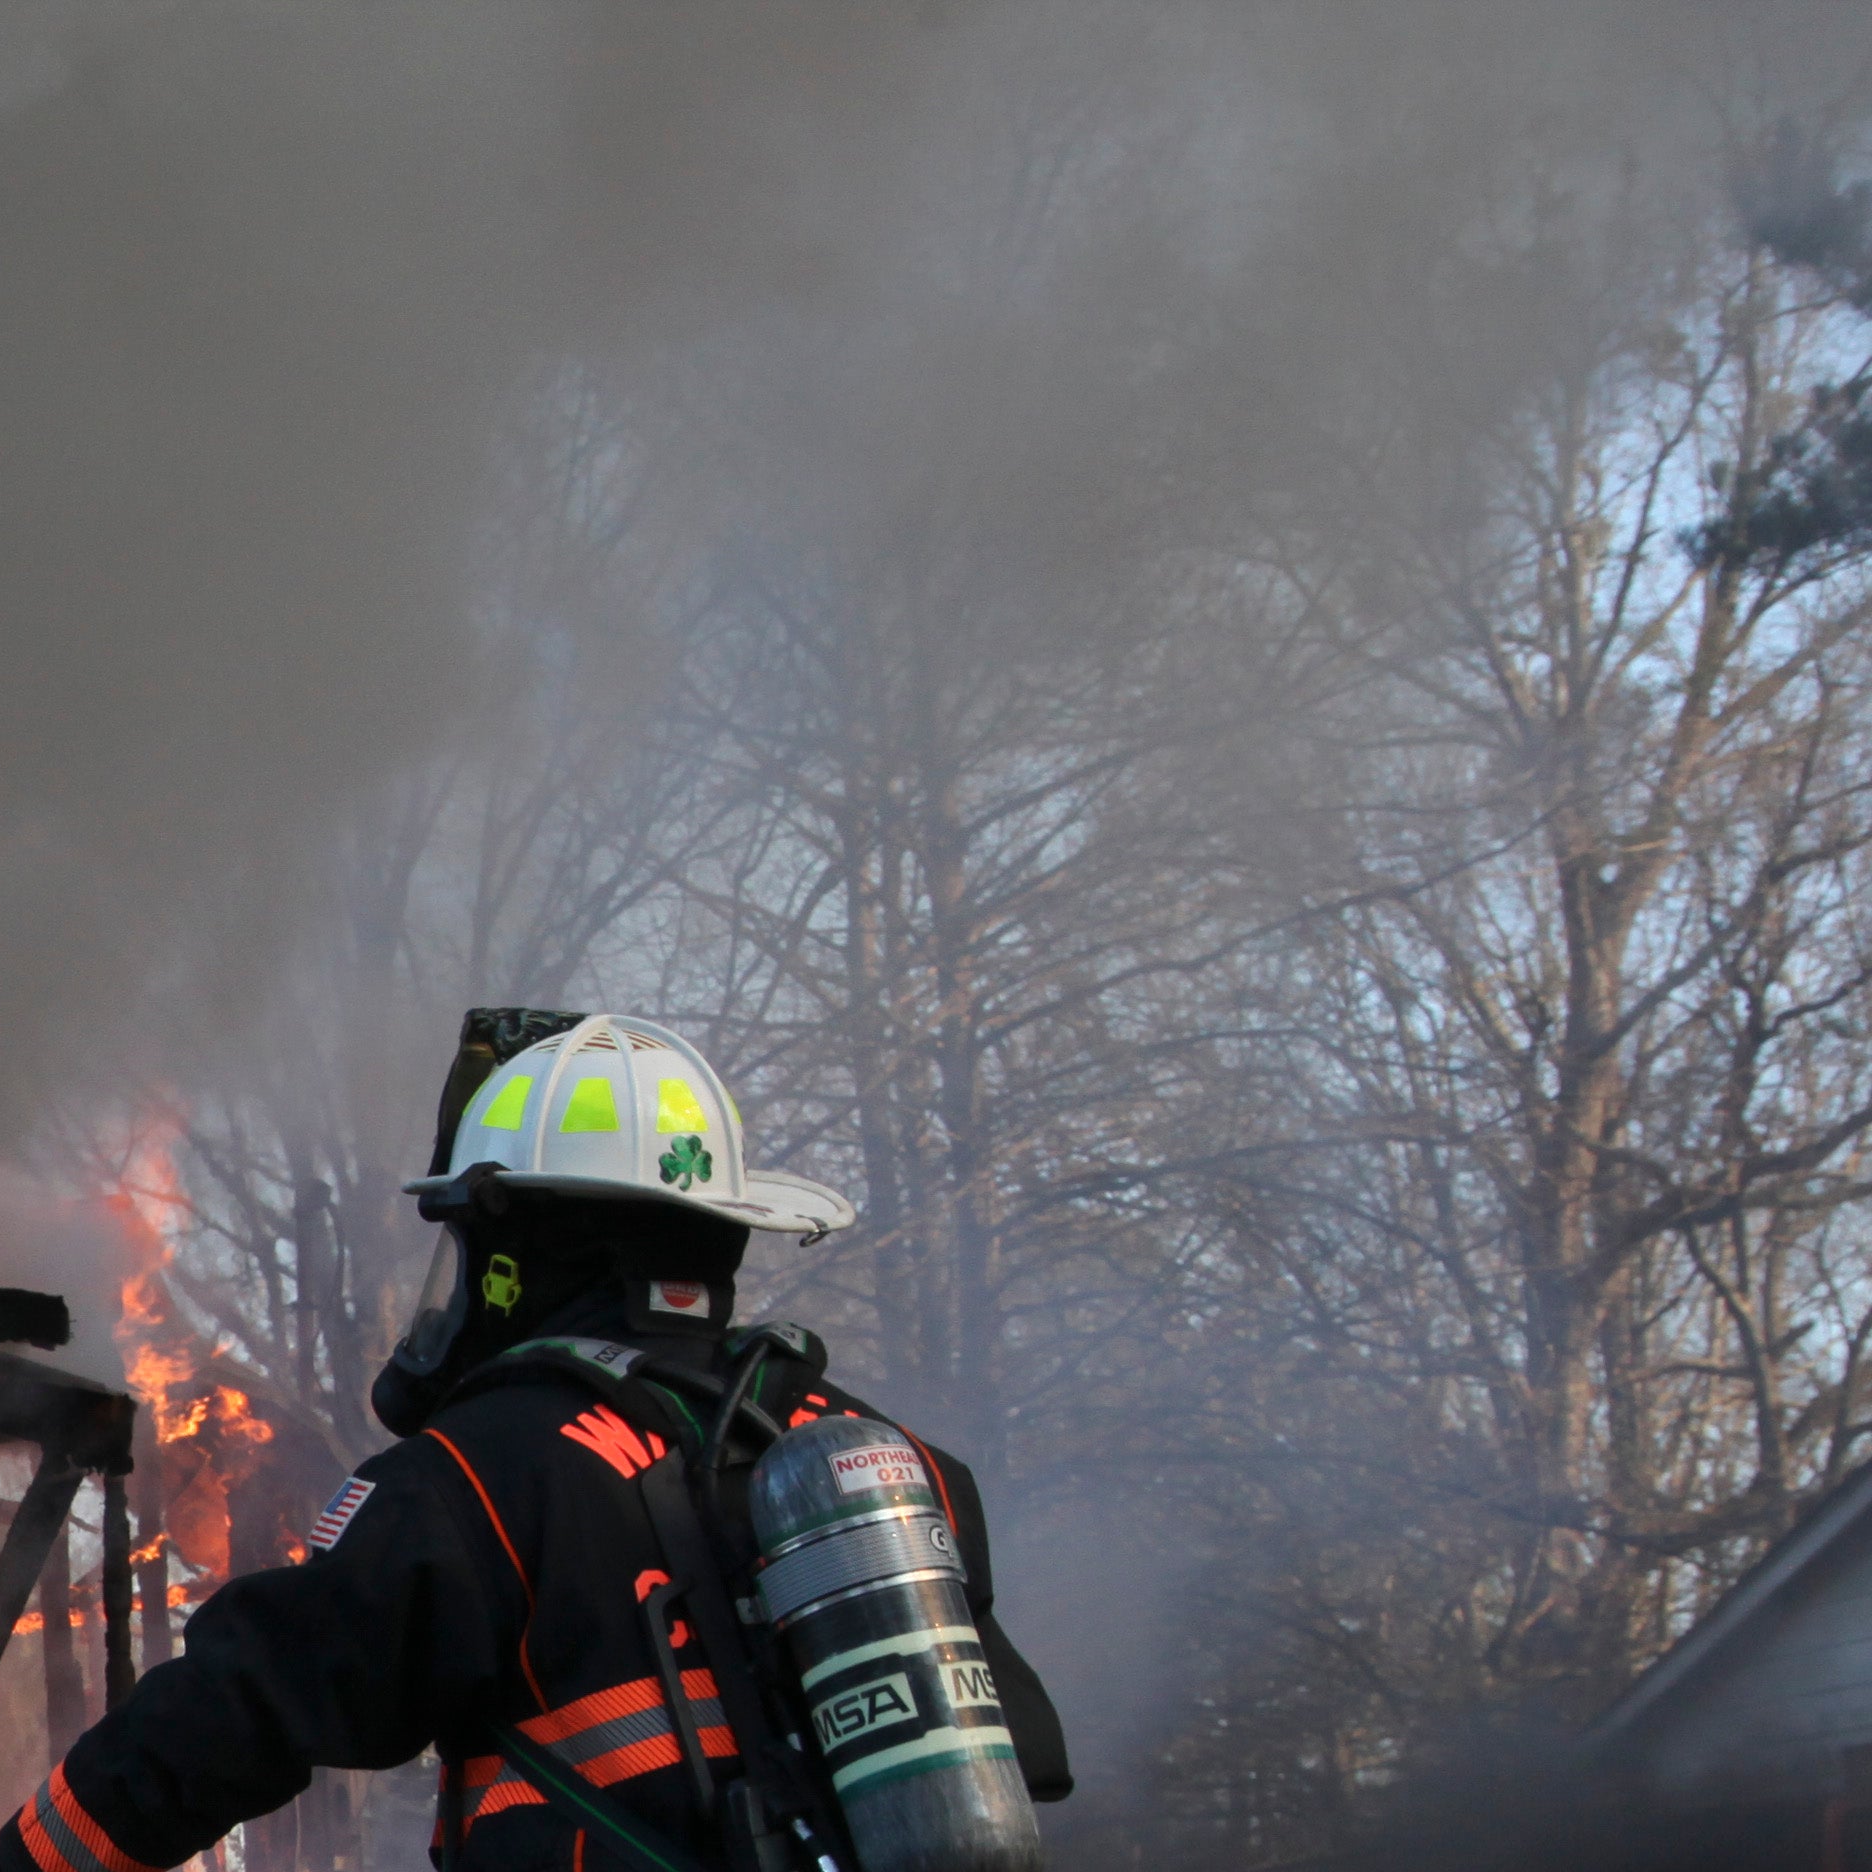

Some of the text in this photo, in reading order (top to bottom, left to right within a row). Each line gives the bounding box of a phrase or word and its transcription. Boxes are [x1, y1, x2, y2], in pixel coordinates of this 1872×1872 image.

[877, 1466, 915, 1482] 021
[813, 1667, 996, 1745] MSA MS
